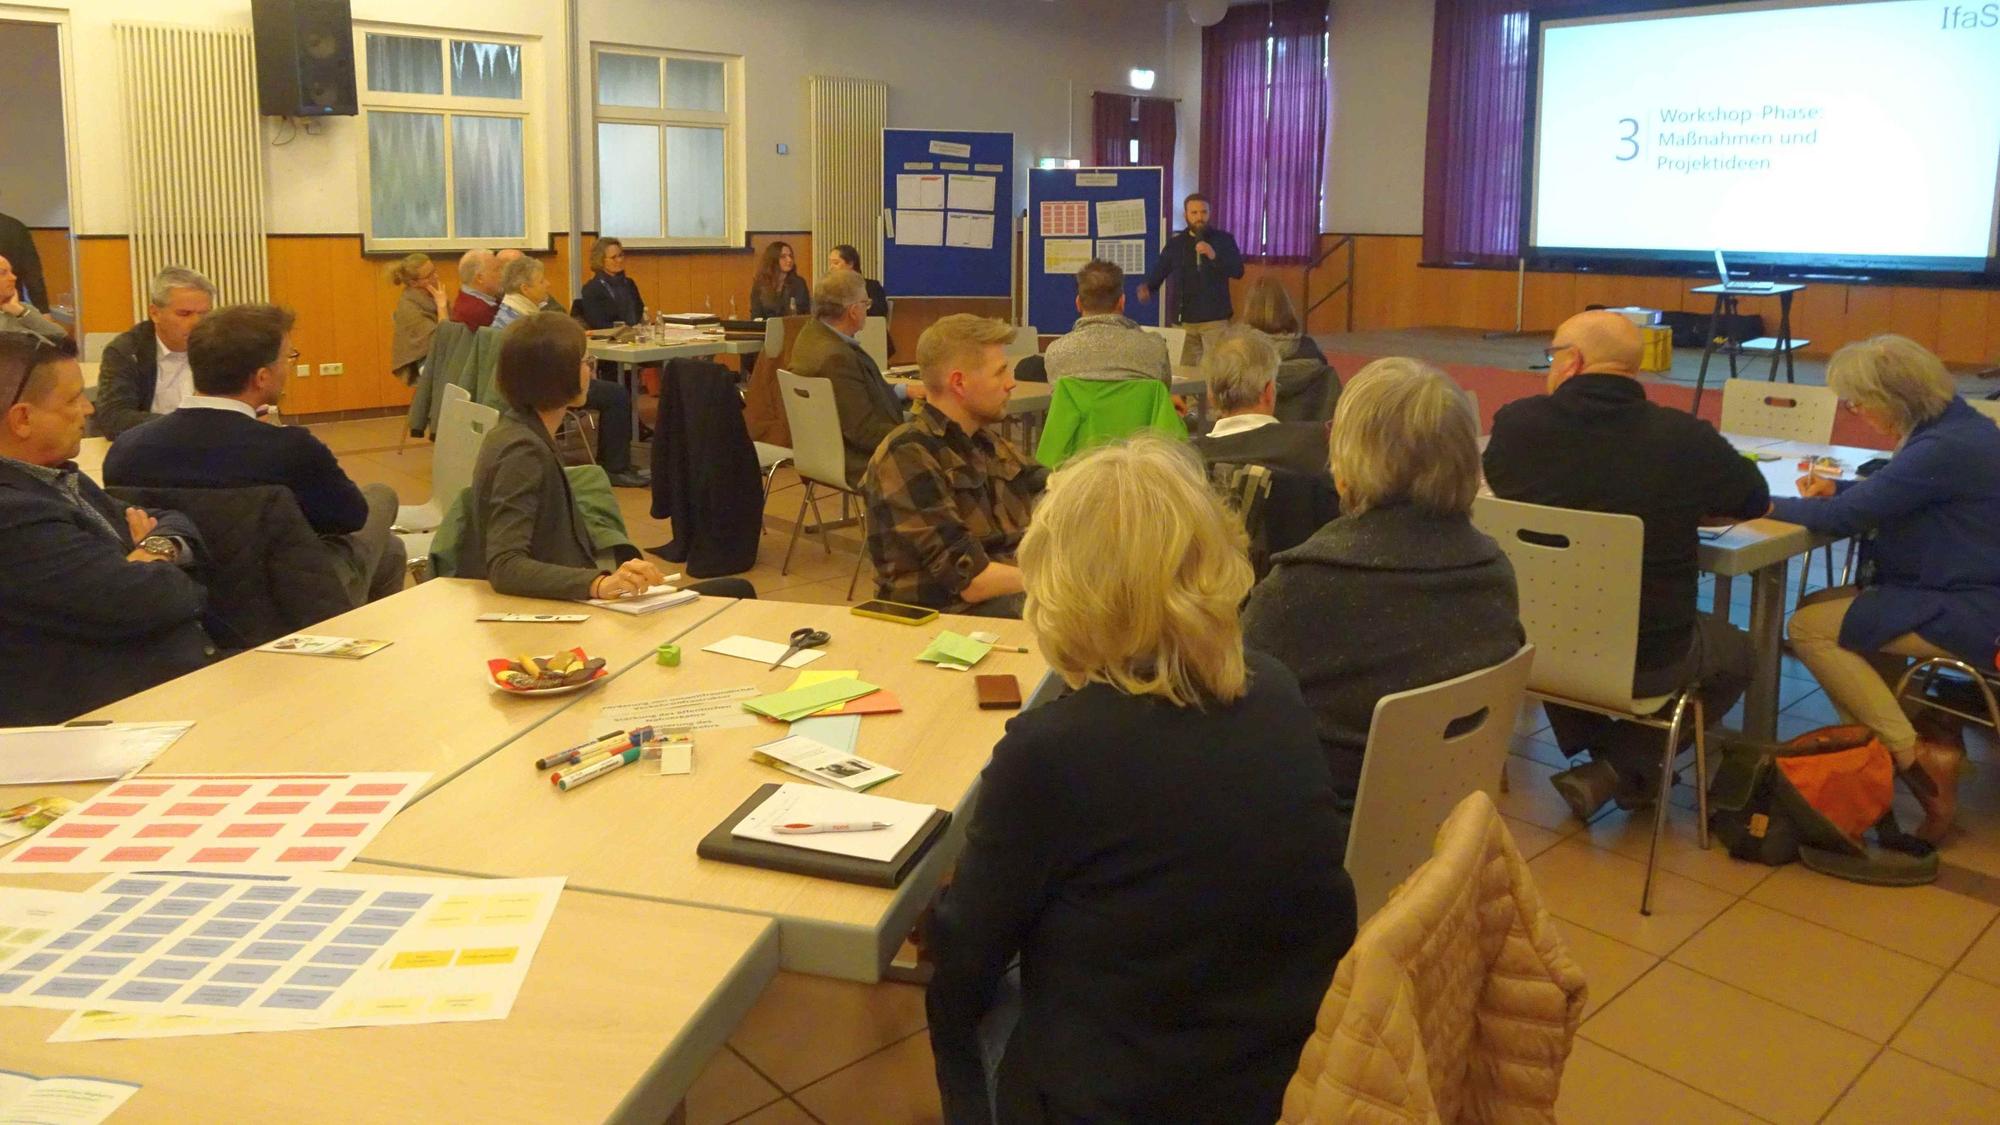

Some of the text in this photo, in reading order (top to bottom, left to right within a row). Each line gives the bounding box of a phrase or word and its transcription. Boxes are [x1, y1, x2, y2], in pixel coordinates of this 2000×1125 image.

[1941, 3, 1999, 29] IfaS
[1615, 117, 1640, 161] 3
[1658, 128, 1818, 147] Maßnahmen und
[1656, 154, 1771, 175] Projektideen
